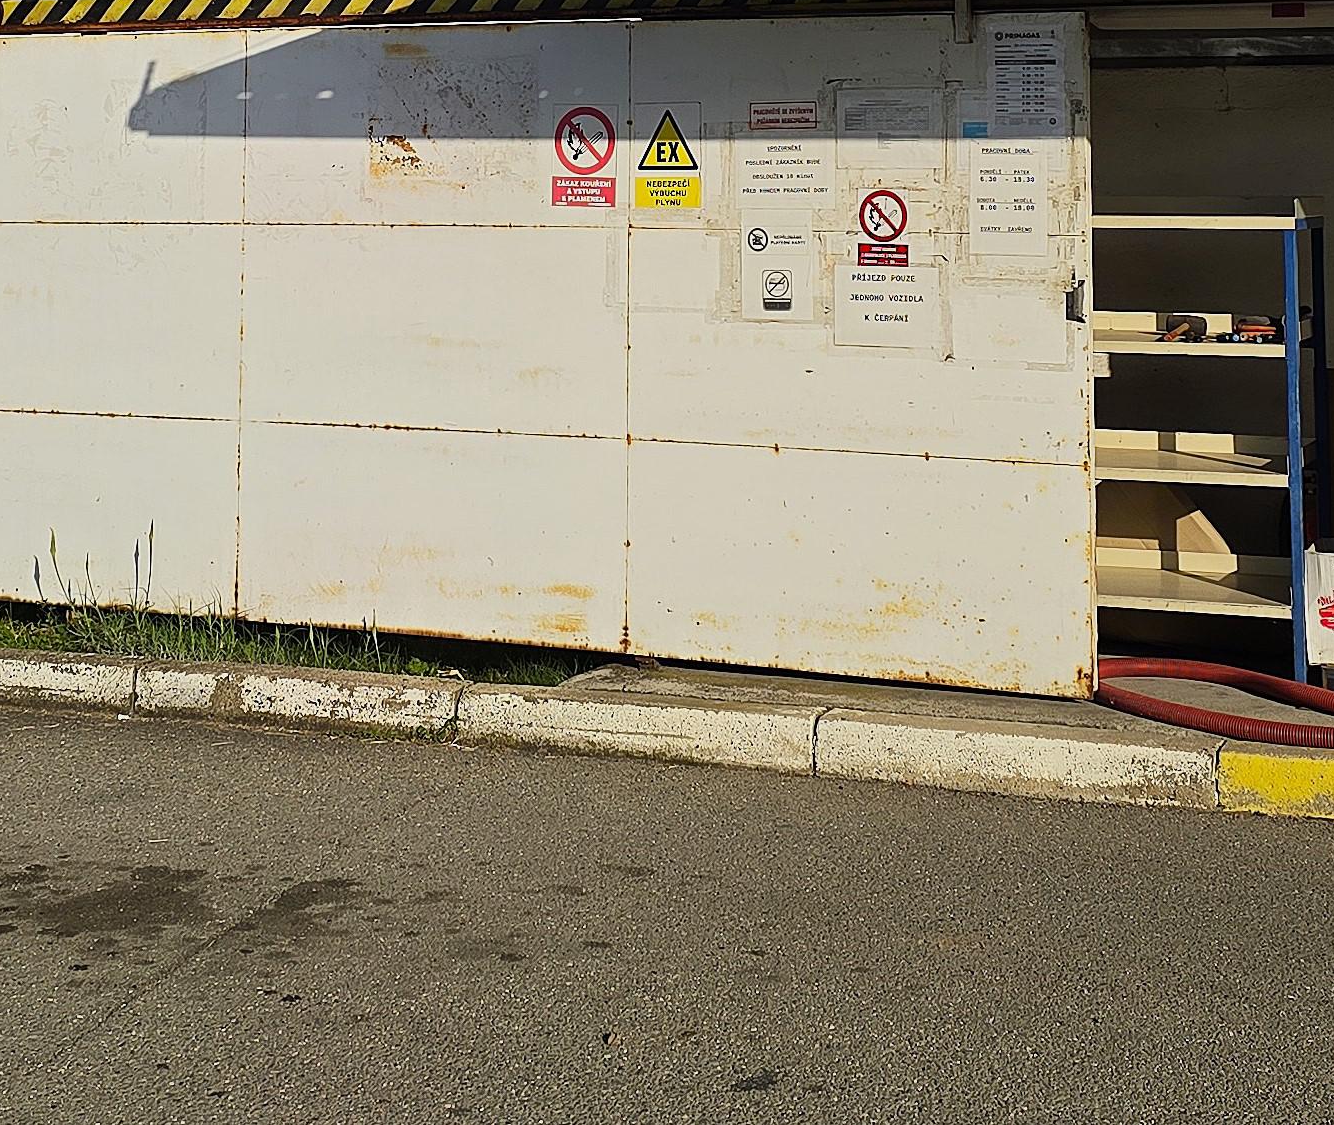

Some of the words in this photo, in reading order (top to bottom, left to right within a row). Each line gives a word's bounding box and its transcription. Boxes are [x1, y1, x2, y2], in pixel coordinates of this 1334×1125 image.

[657, 142, 679, 162] EX
[556, 179, 579, 187] ZÁKAZ
[580, 179, 611, 188] KOUŘENÍ
[647, 179, 690, 187] NEBEZPEČÍ
[650, 189, 687, 197] VÝBUCHU
[852, 273, 886, 281] PŘÍJEZD
